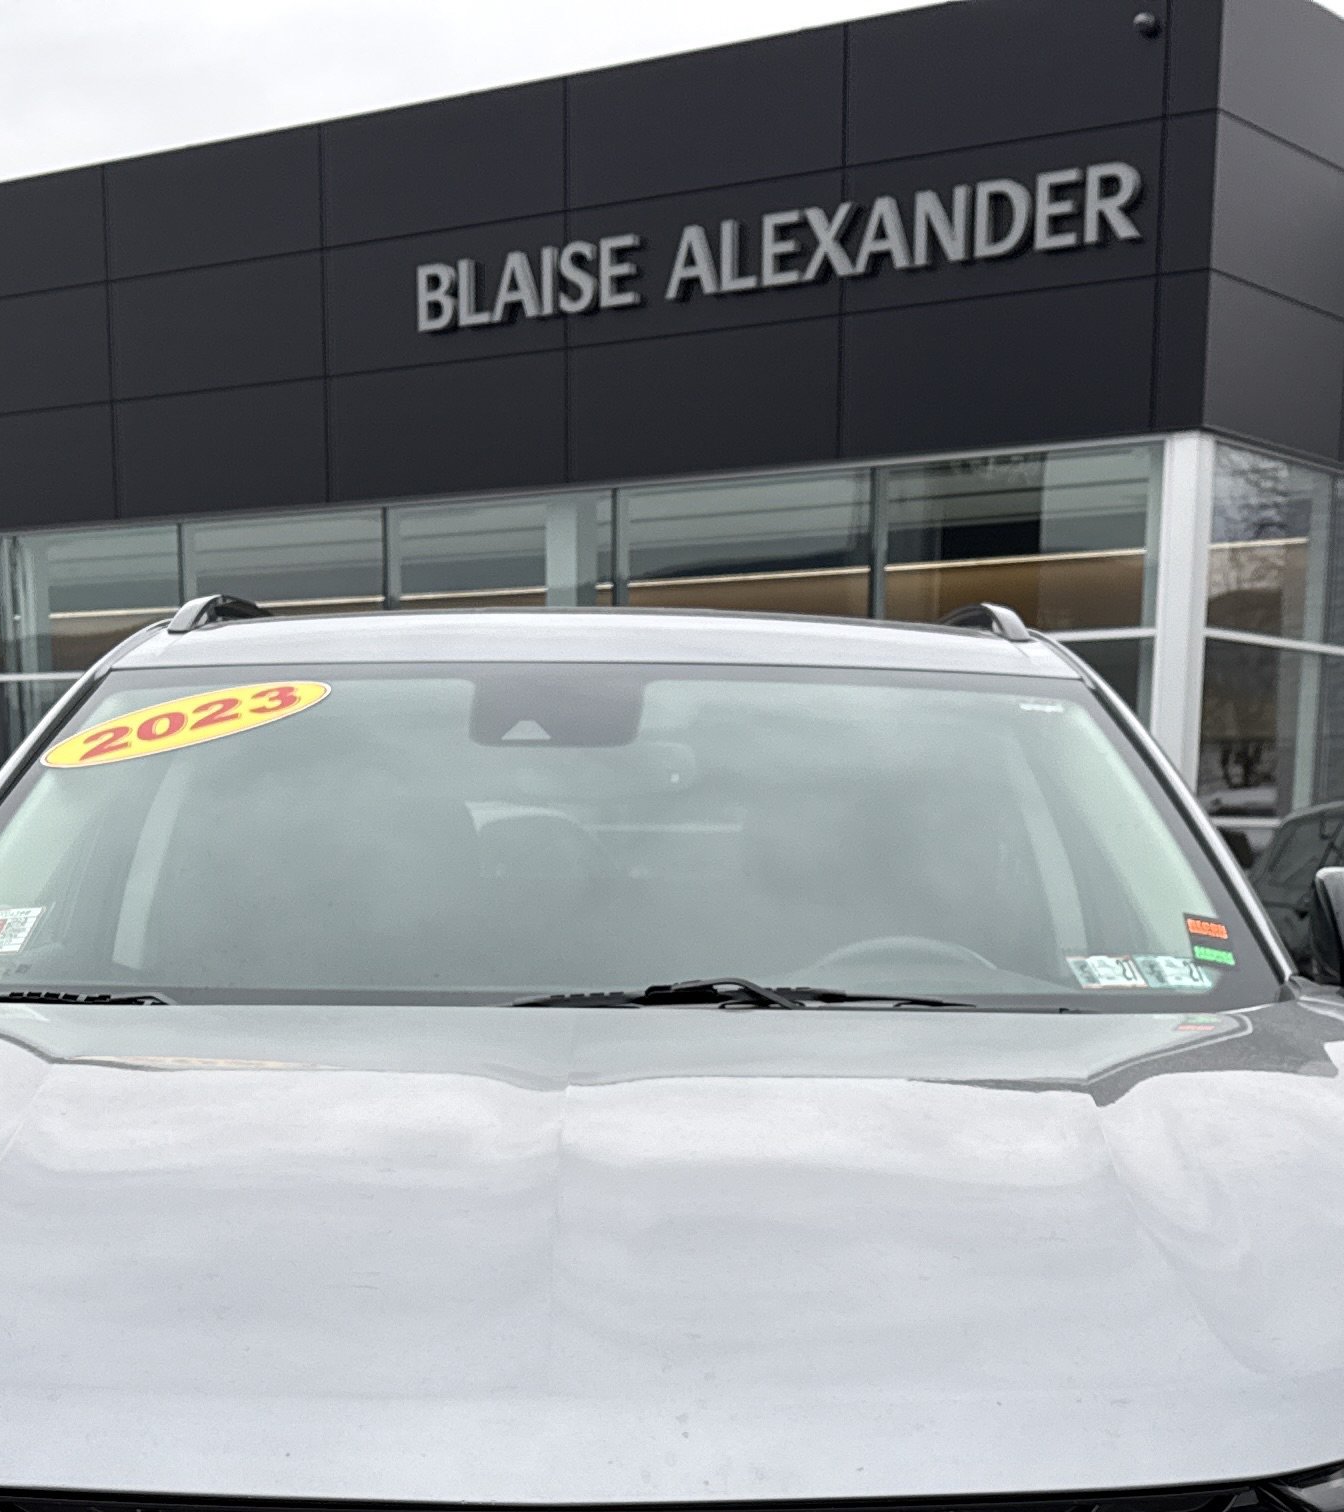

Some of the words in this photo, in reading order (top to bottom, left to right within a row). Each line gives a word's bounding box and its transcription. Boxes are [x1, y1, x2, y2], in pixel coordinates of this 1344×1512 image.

[416, 233, 640, 333] BLAISE
[665, 161, 1143, 302] ALEXANDER
[78, 686, 302, 762] 2023
